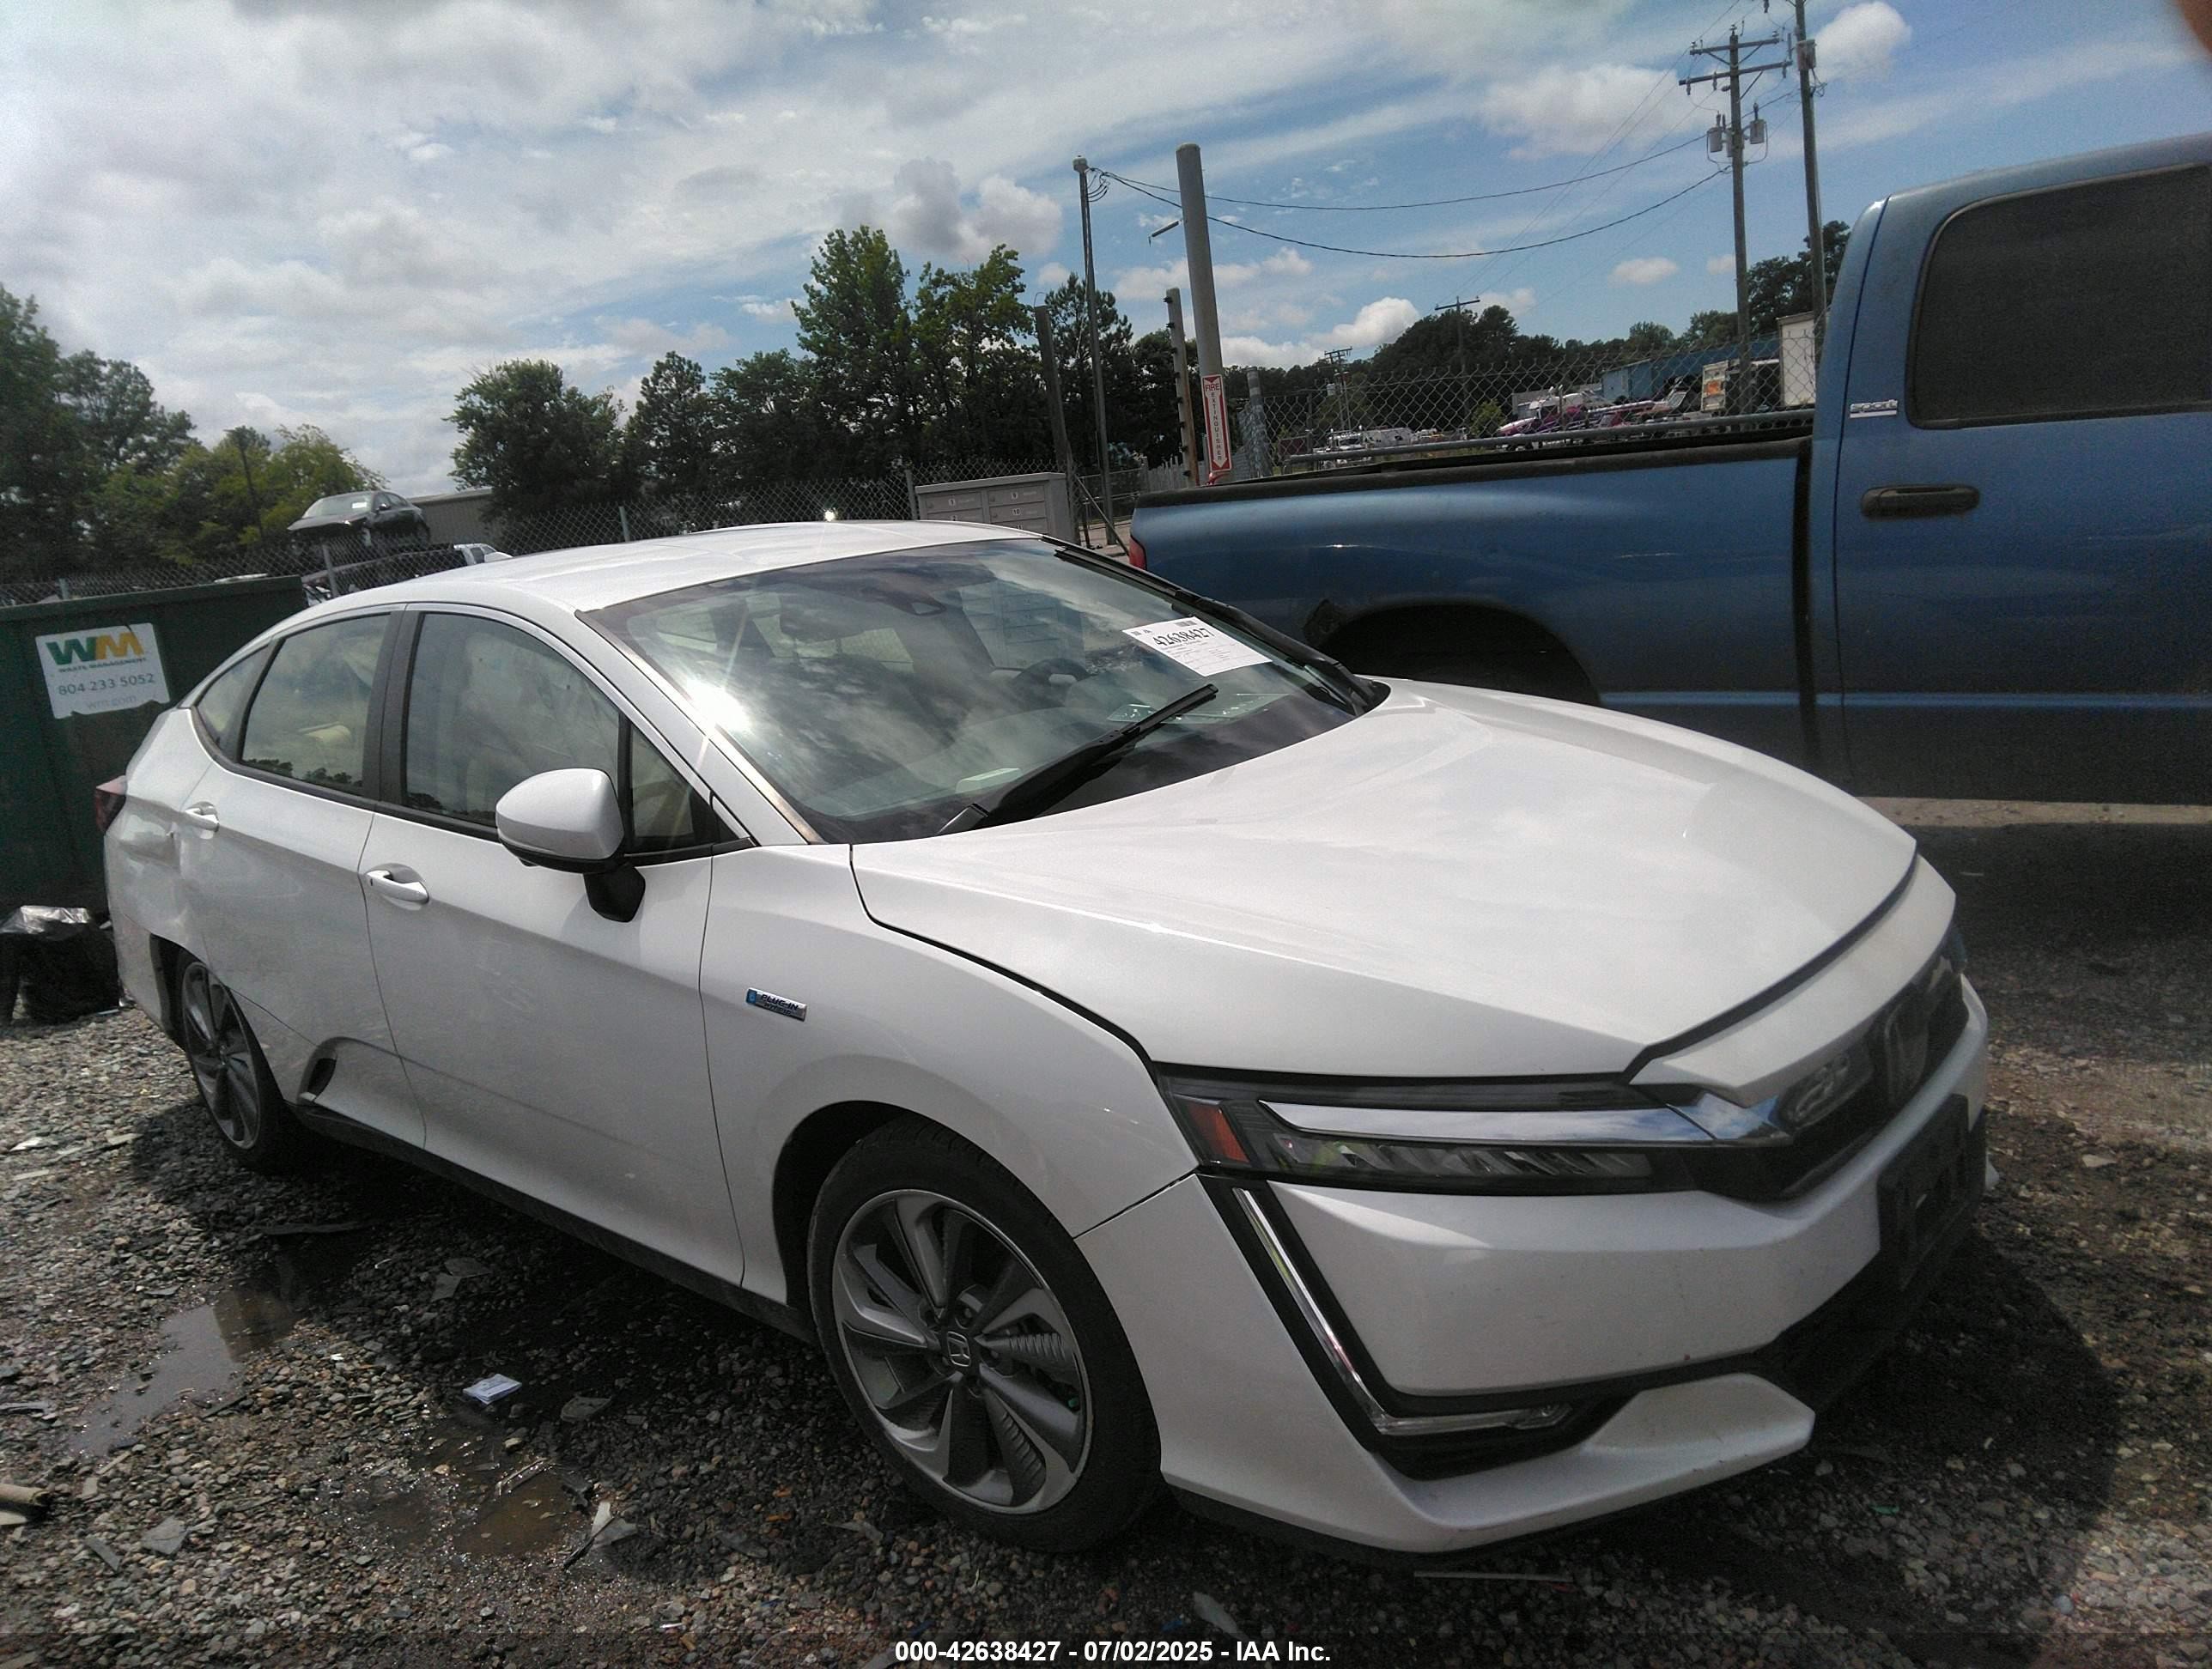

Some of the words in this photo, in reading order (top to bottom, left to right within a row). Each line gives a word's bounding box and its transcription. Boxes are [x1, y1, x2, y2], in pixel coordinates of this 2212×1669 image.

[1205, 383, 1220, 391] FIRE
[1212, 392, 1221, 460] EXTINGUISHER
[1152, 628, 1215, 646] 42638427
[46, 632, 144, 665] WM
[58, 683, 85, 695] 804
[90, 678, 116, 691] 233
[119, 673, 155, 687] 5052
[761, 994, 799, 1011] PLUG-IN
